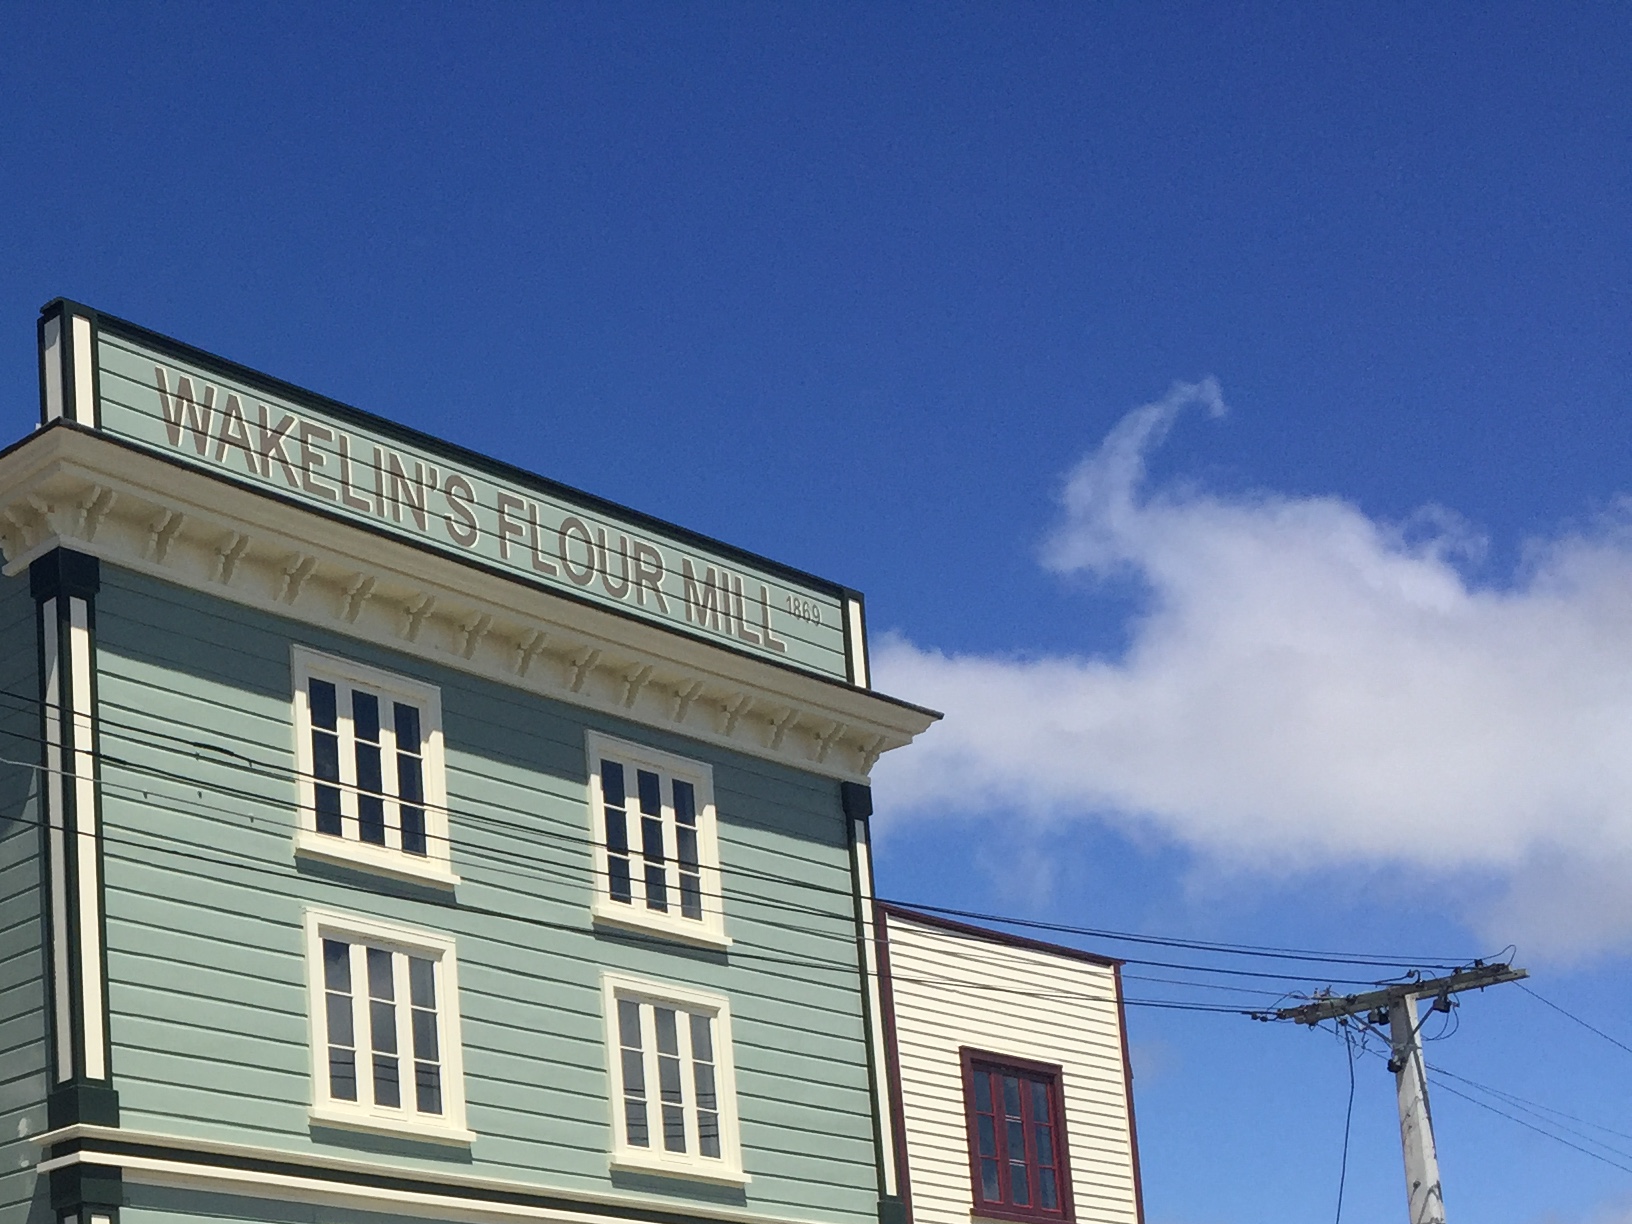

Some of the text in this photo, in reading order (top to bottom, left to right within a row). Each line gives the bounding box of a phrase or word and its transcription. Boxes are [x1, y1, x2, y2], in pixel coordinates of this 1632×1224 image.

[155, 366, 787, 652] WAKELIN'S FLOUR MILL
[786, 595, 823, 626] 1869
